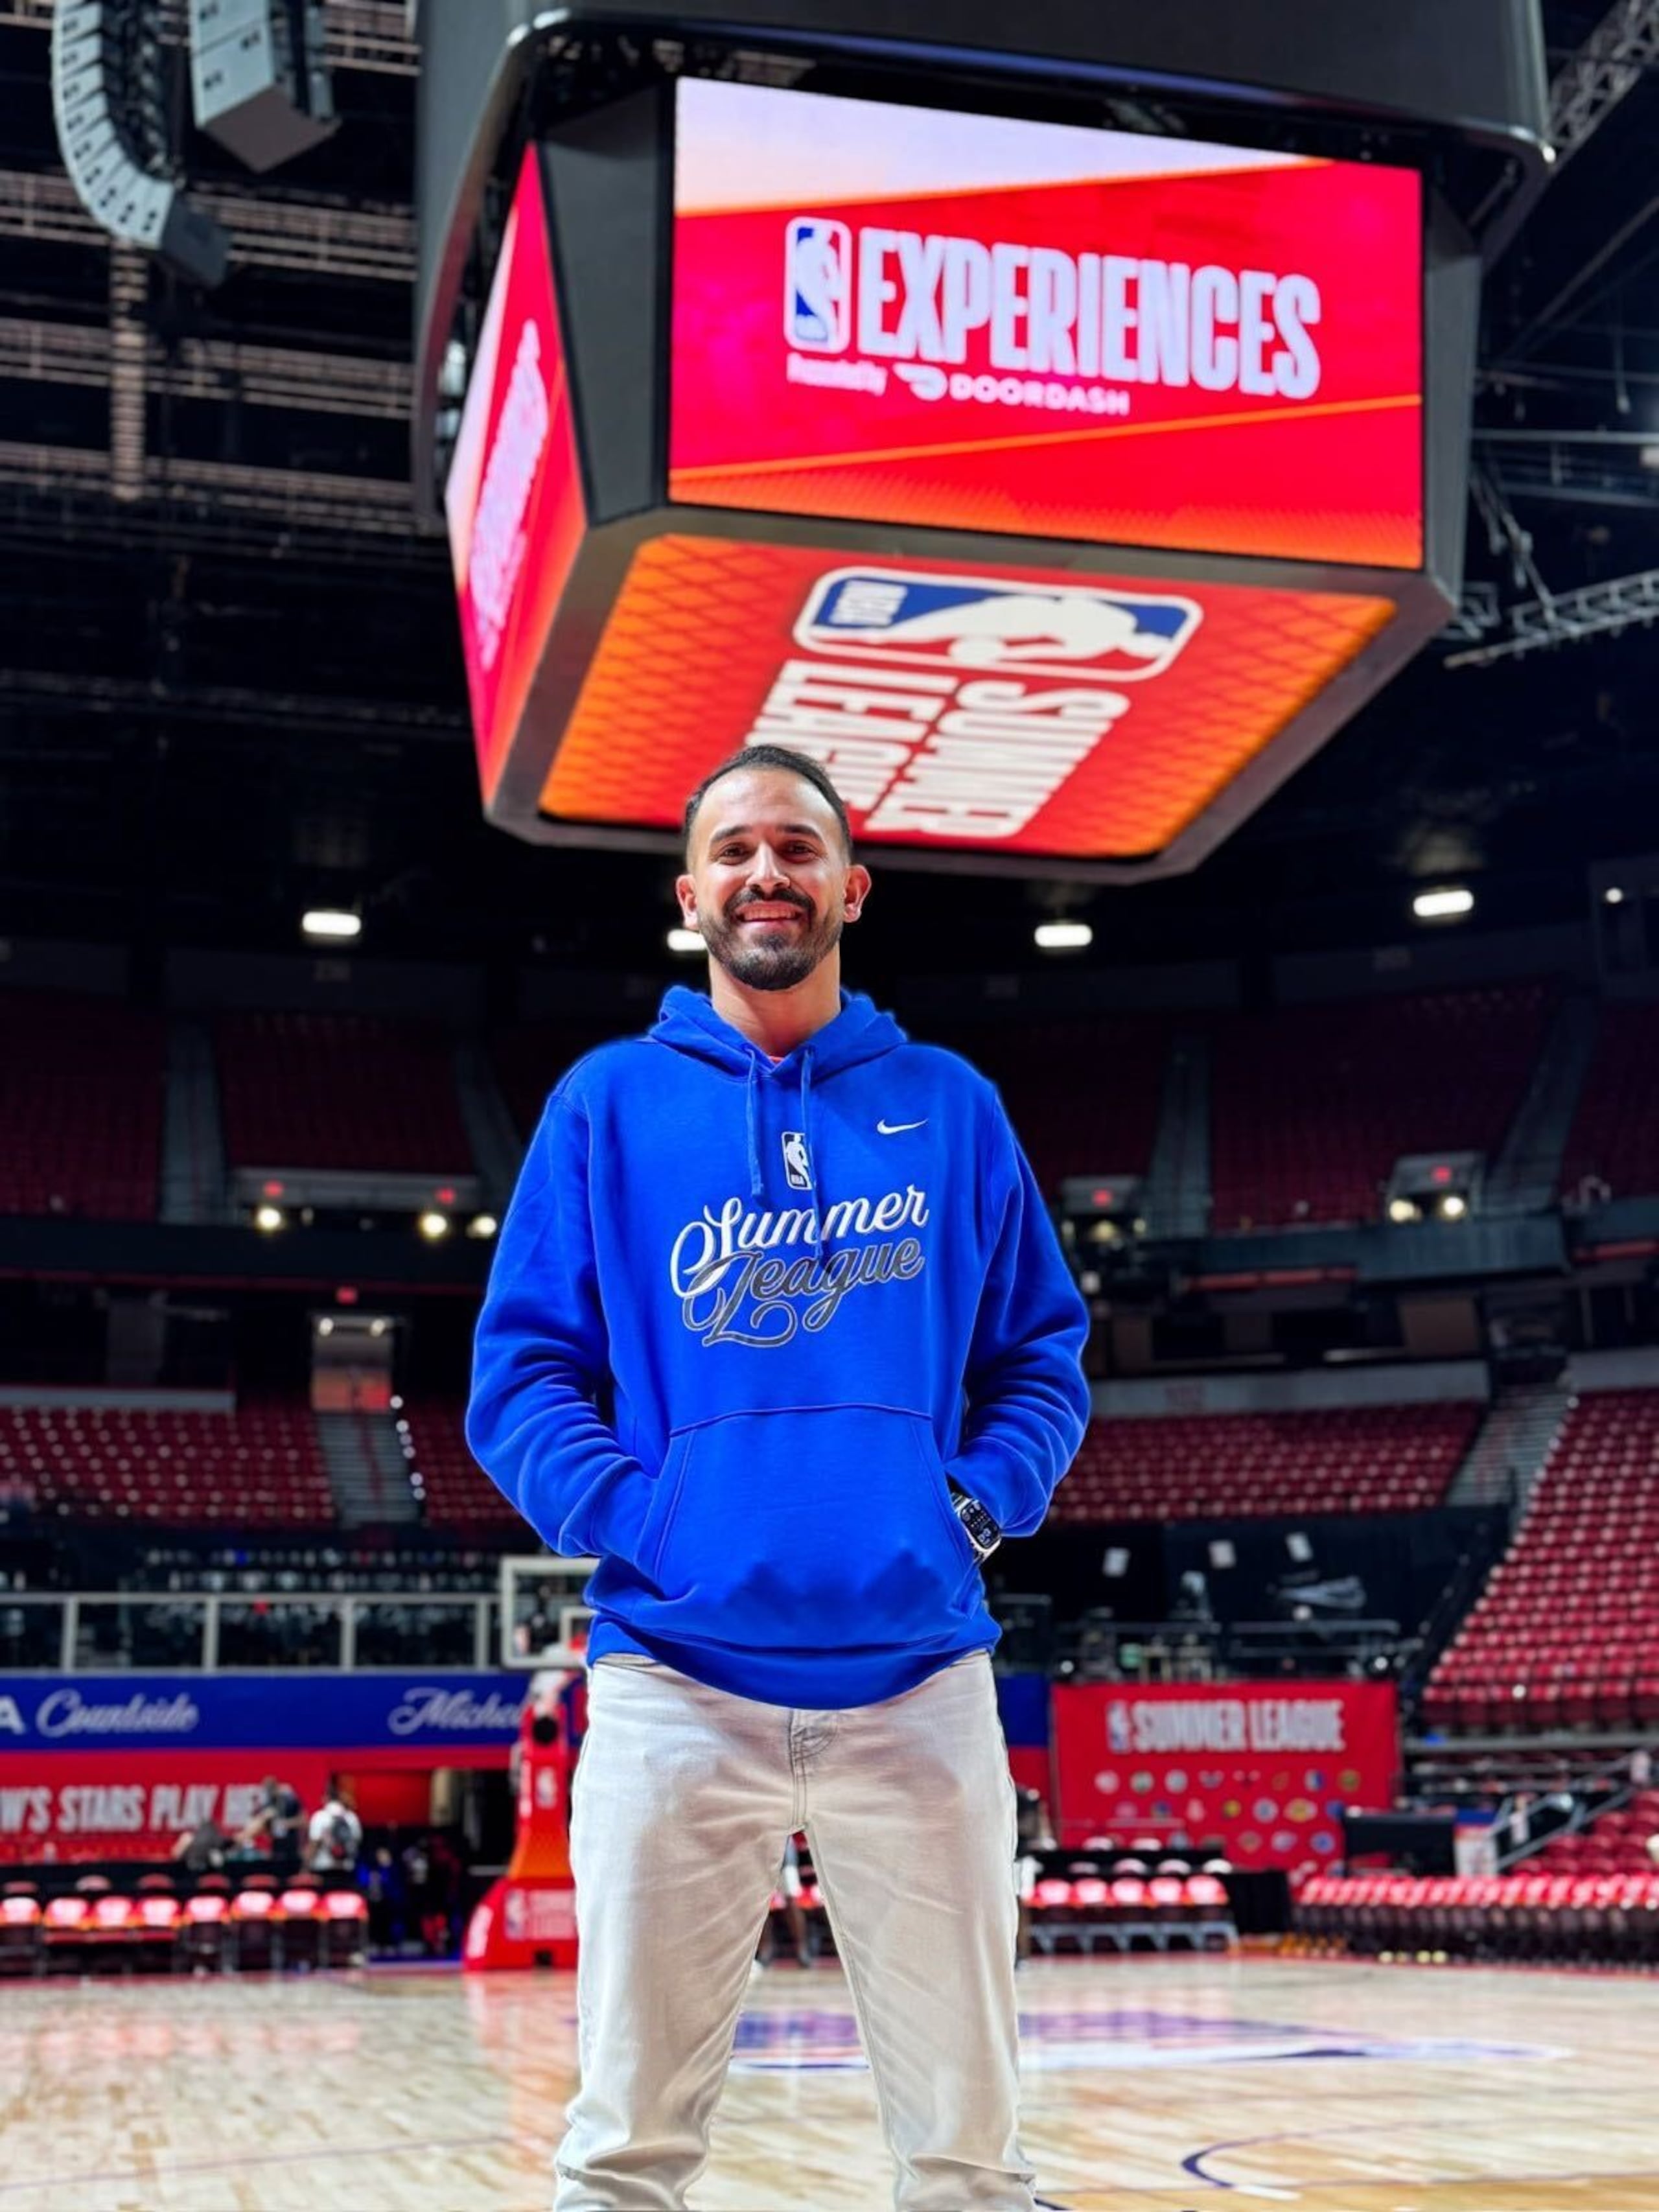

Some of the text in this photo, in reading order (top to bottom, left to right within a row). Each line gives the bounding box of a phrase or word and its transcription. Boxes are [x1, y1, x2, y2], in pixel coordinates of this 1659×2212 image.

[857, 226, 1321, 400] EXPERIENCES
[949, 373, 1130, 416] DOORDASH
[745, 658, 959, 811] LEAG
[864, 680, 1130, 837] SUMMER
[671, 1184, 929, 1298] Summer
[682, 1238, 925, 1348] League
[1133, 1699, 1347, 1752] SUMMER LEAGUE
[58, 1785, 146, 1832] STARS
[150, 1784, 219, 1832] PLAY
